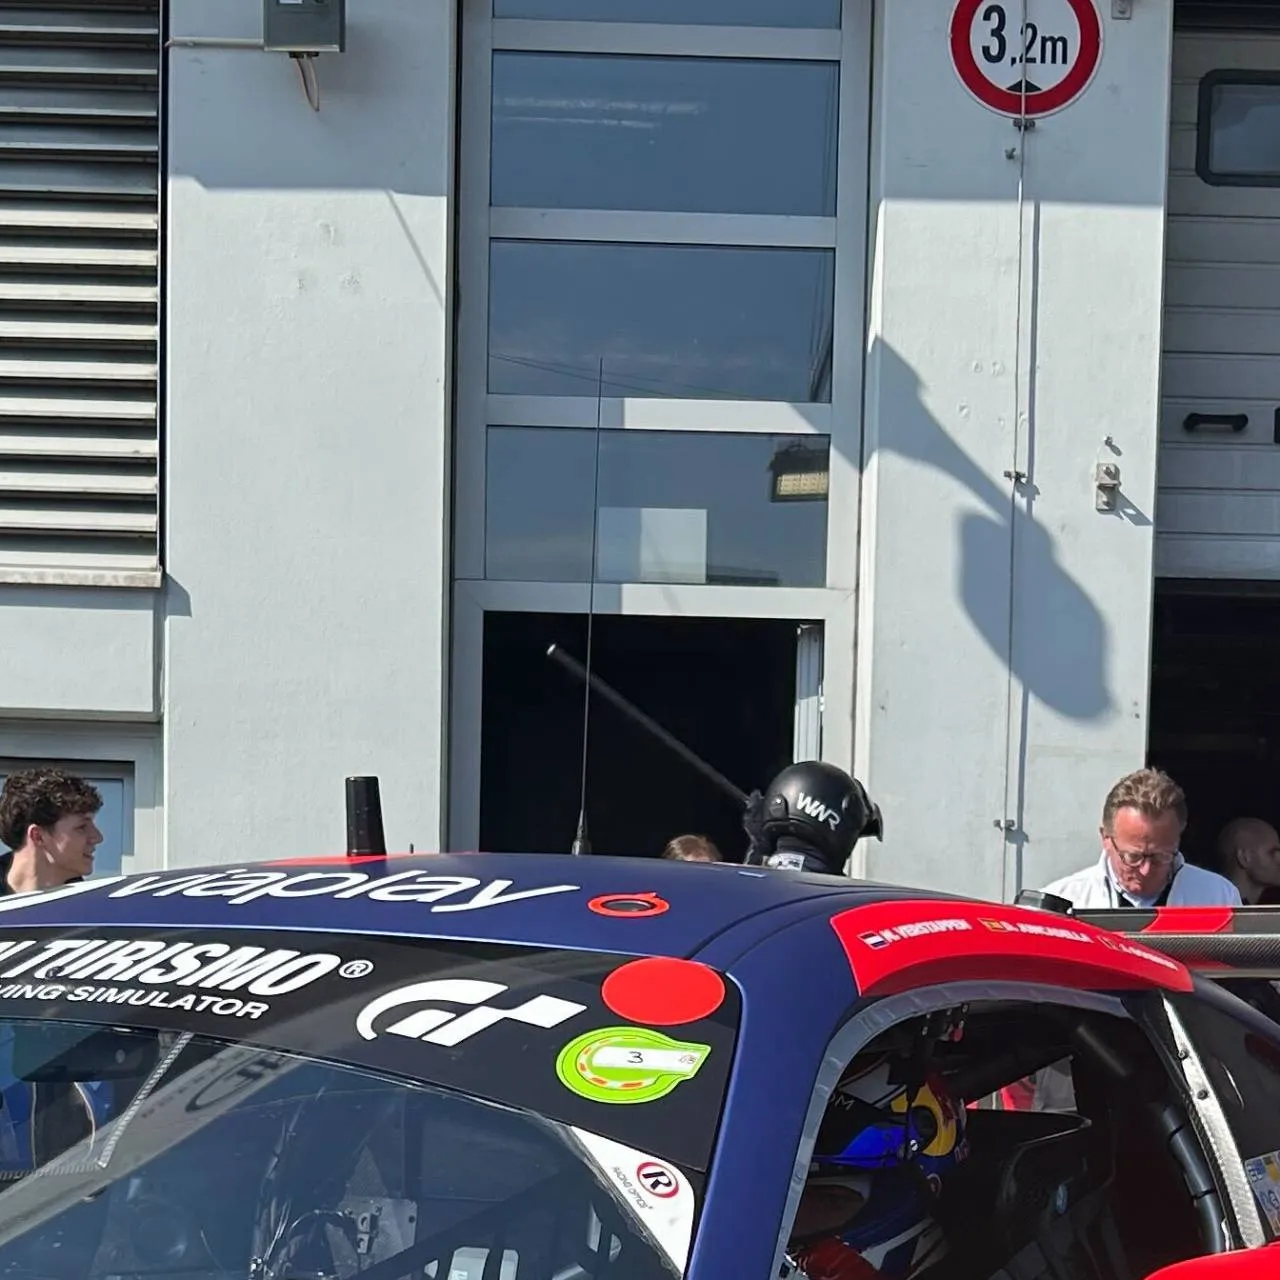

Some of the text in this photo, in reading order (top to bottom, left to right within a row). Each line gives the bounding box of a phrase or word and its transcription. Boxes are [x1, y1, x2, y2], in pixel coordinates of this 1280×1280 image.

[982, 4, 1068, 67] 3,2m
[109, 869, 581, 913] viaplay
[66, 984, 271, 1020] SIMULATOR
[626, 1050, 645, 1065] 3
